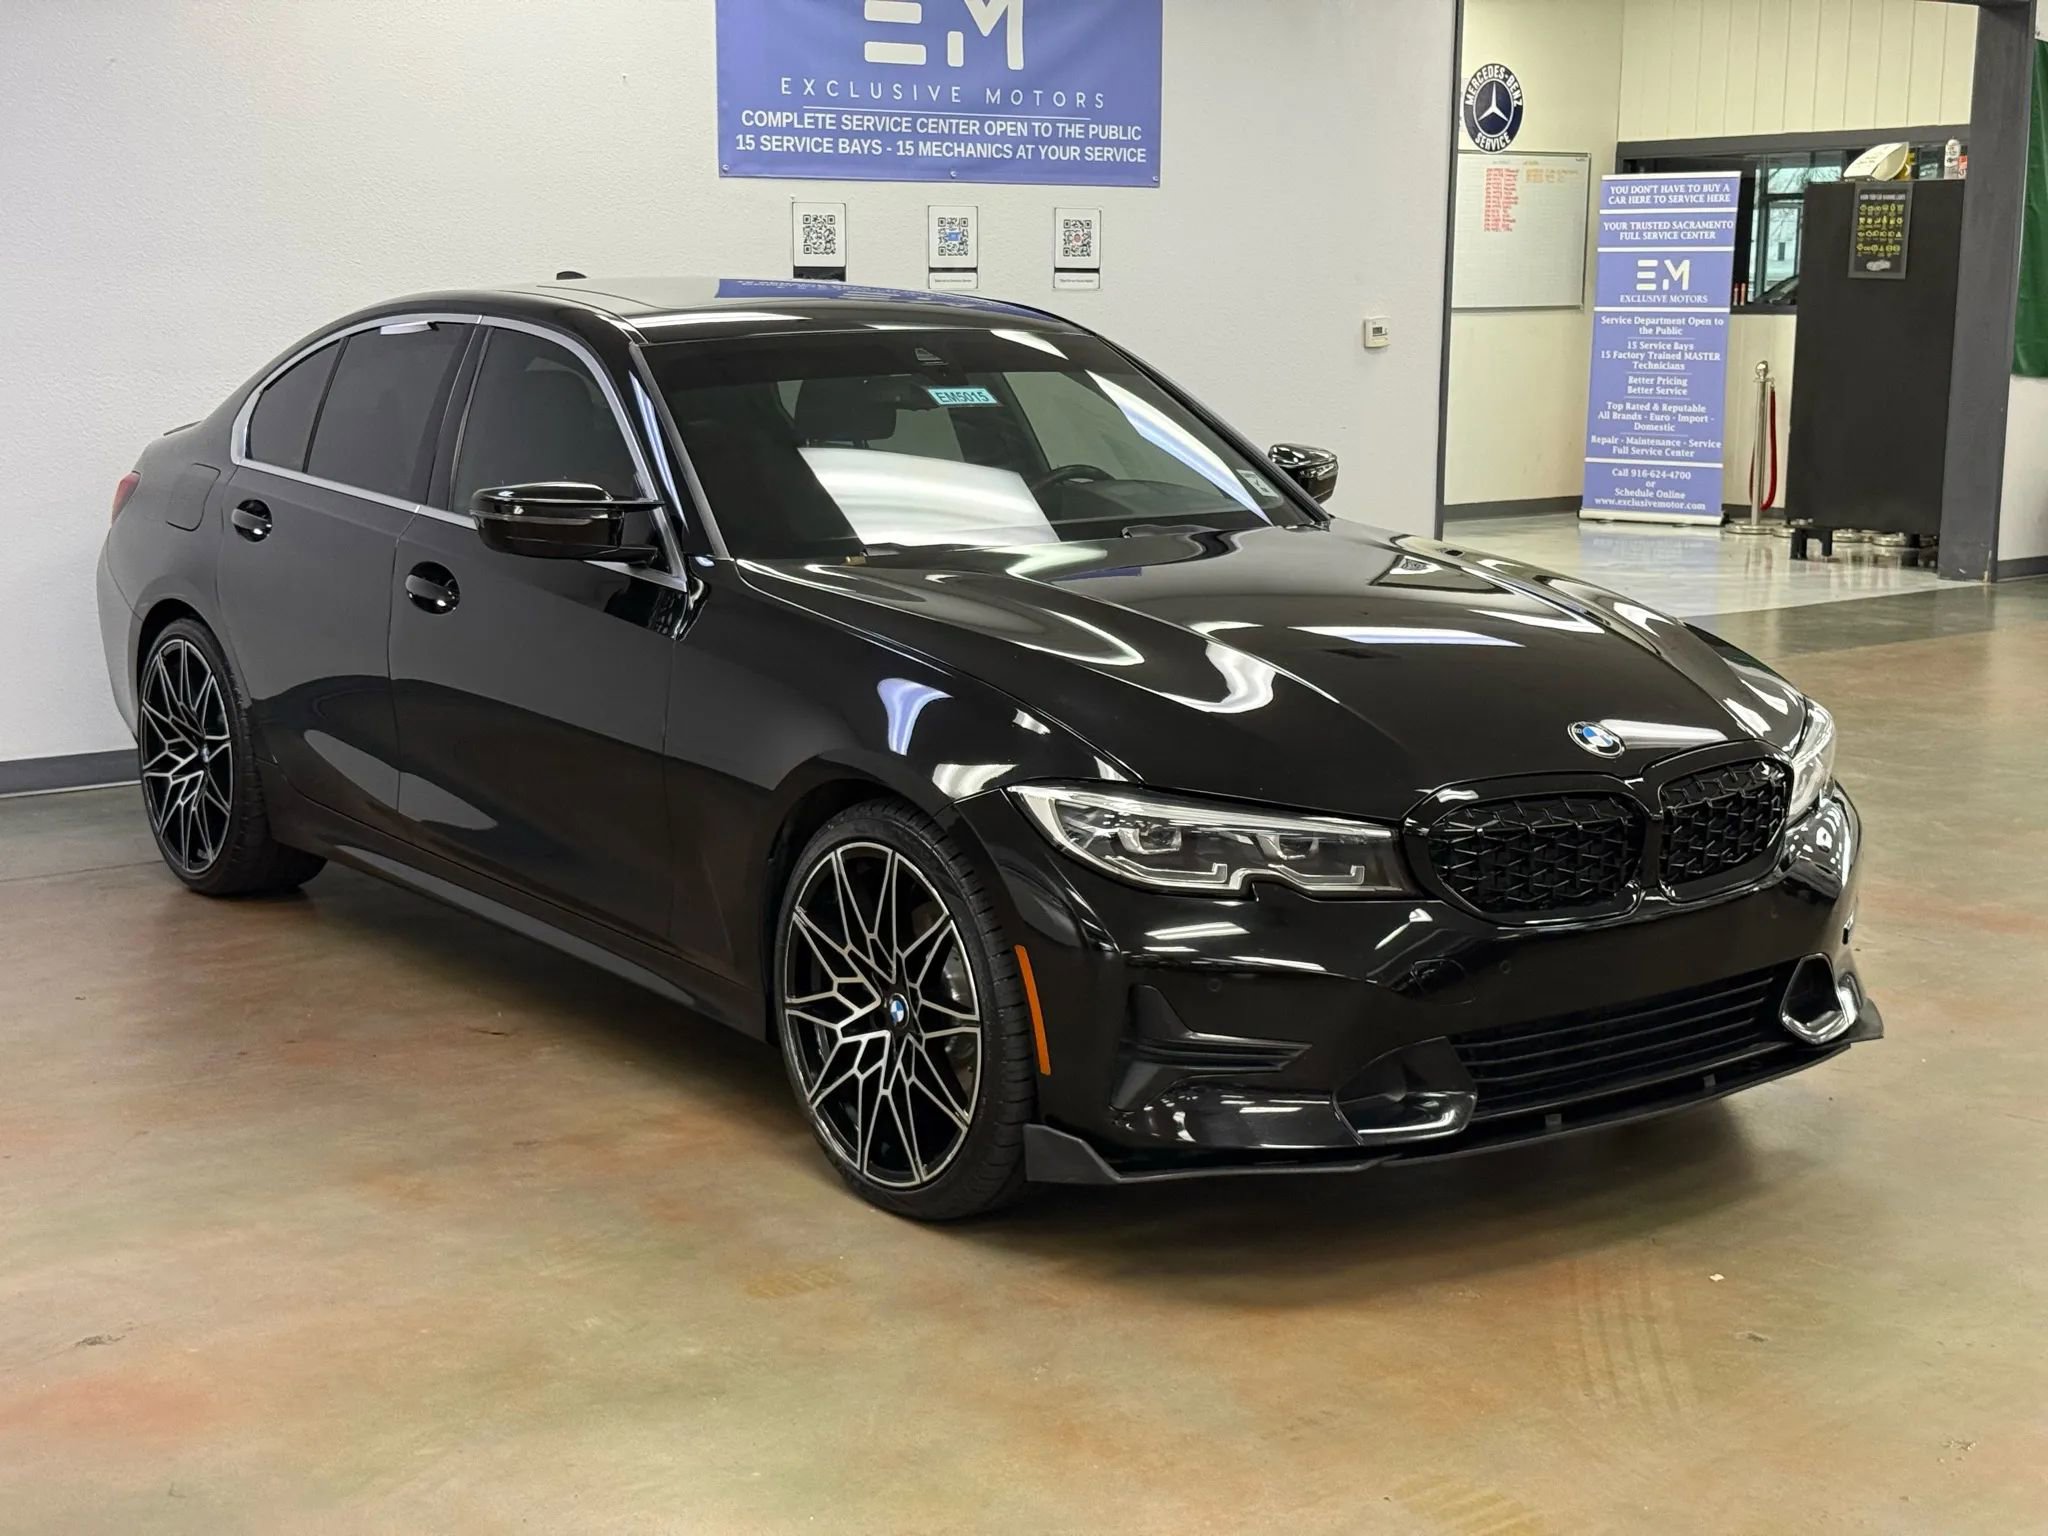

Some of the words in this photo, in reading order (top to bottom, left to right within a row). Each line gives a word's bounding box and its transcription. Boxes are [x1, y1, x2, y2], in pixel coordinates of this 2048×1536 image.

[781, 77, 961, 103] EXCLUSIVE
[985, 88, 1104, 109] MOTORS
[741, 110, 837, 129] COMPLETE
[840, 114, 912, 133] SERVICE
[916, 117, 980, 135] CENTER
[984, 120, 1028, 137] OPEN
[1031, 122, 1052, 138] TO
[1056, 123, 1085, 139] THE
[1089, 124, 1142, 141] PUBLIC
[1475, 132, 1511, 151] SERVICE
[735, 134, 755, 151] 15
[759, 135, 833, 154] SERVICE
[838, 138, 882, 155] BAYS
[896, 140, 914, 156] 15
[918, 141, 1012, 159] MECHANICS
[1016, 144, 1035, 160] AT
[1038, 145, 1081, 161] YOUR
[1084, 146, 1147, 163] SERVICE
[1610, 186, 1629, 195] YOU
[1631, 185, 1659, 194] DON'T
[1661, 184, 1686, 193] HAVE
[1687, 184, 1701, 193] TO
[1703, 183, 1721, 193] BUY
[1723, 183, 1730, 192] A
[1608, 196, 1627, 205] CAR
[1628, 195, 1652, 205] HERE
[1653, 195, 1666, 204] TO
[1668, 194, 1705, 204] SERVICE
[1707, 193, 1731, 202] HERE
[1603, 222, 1628, 230] YOUR
[1630, 221, 1670, 230] TRUSTED
[1672, 220, 1734, 230] SACRAMENTO
[1620, 232, 1641, 240] FULL
[1643, 231, 1678, 240] SERVICE
[1680, 231, 1716, 240] CENTER
[1636, 259, 1690, 291] EM
[1620, 295, 1668, 303] EXCLUSIVE
[1669, 295, 1708, 303] MOTORS
[1601, 316, 1632, 325] Service
[1634, 316, 1686, 326] Department
[1687, 317, 1712, 327] Open
[1714, 317, 1724, 326] to
[1639, 326, 1653, 335] the
[1655, 326, 1683, 335] Public
[1627, 341, 1638, 350] 15
[1639, 341, 1672, 350] Service
[1674, 342, 1694, 351] Bays
[1601, 351, 1611, 359] 15
[1612, 351, 1645, 361] Factory
[1647, 351, 1682, 360] Trained
[1683, 352, 1721, 360] MASTER
[1632, 361, 1685, 370] Technicians
[1628, 376, 1654, 385] Better
[1656, 376, 1688, 387] Pricing
[1627, 386, 1653, 395] Better
[1655, 386, 1688, 395] Service
[935, 391, 990, 403] EM5015
[1606, 401, 1624, 412] Top
[1625, 402, 1651, 411] Rated
[1652, 403, 1660, 411] &
[1661, 403, 1706, 413] Reputable
[1598, 411, 1610, 420] All
[1612, 411, 1642, 420] Brands
[1649, 413, 1671, 421] Euro
[1678, 414, 1709, 424] Import
[1633, 422, 1676, 432] Domestic
[1591, 435, 1619, 445] Repair
[1626, 437, 1681, 447] Maintenance
[1688, 439, 1722, 448] Service
[1612, 446, 1629, 455] Full
[1630, 447, 1663, 456] Service
[1664, 448, 1695, 457] Center
[1612, 468, 1629, 477] Call
[1631, 469, 1691, 480] 916-624-4700
[1615, 488, 1654, 498] Schedule
[1656, 489, 1686, 499] Online
[1594, 498, 1706, 510] www.exclusivemotor.com
